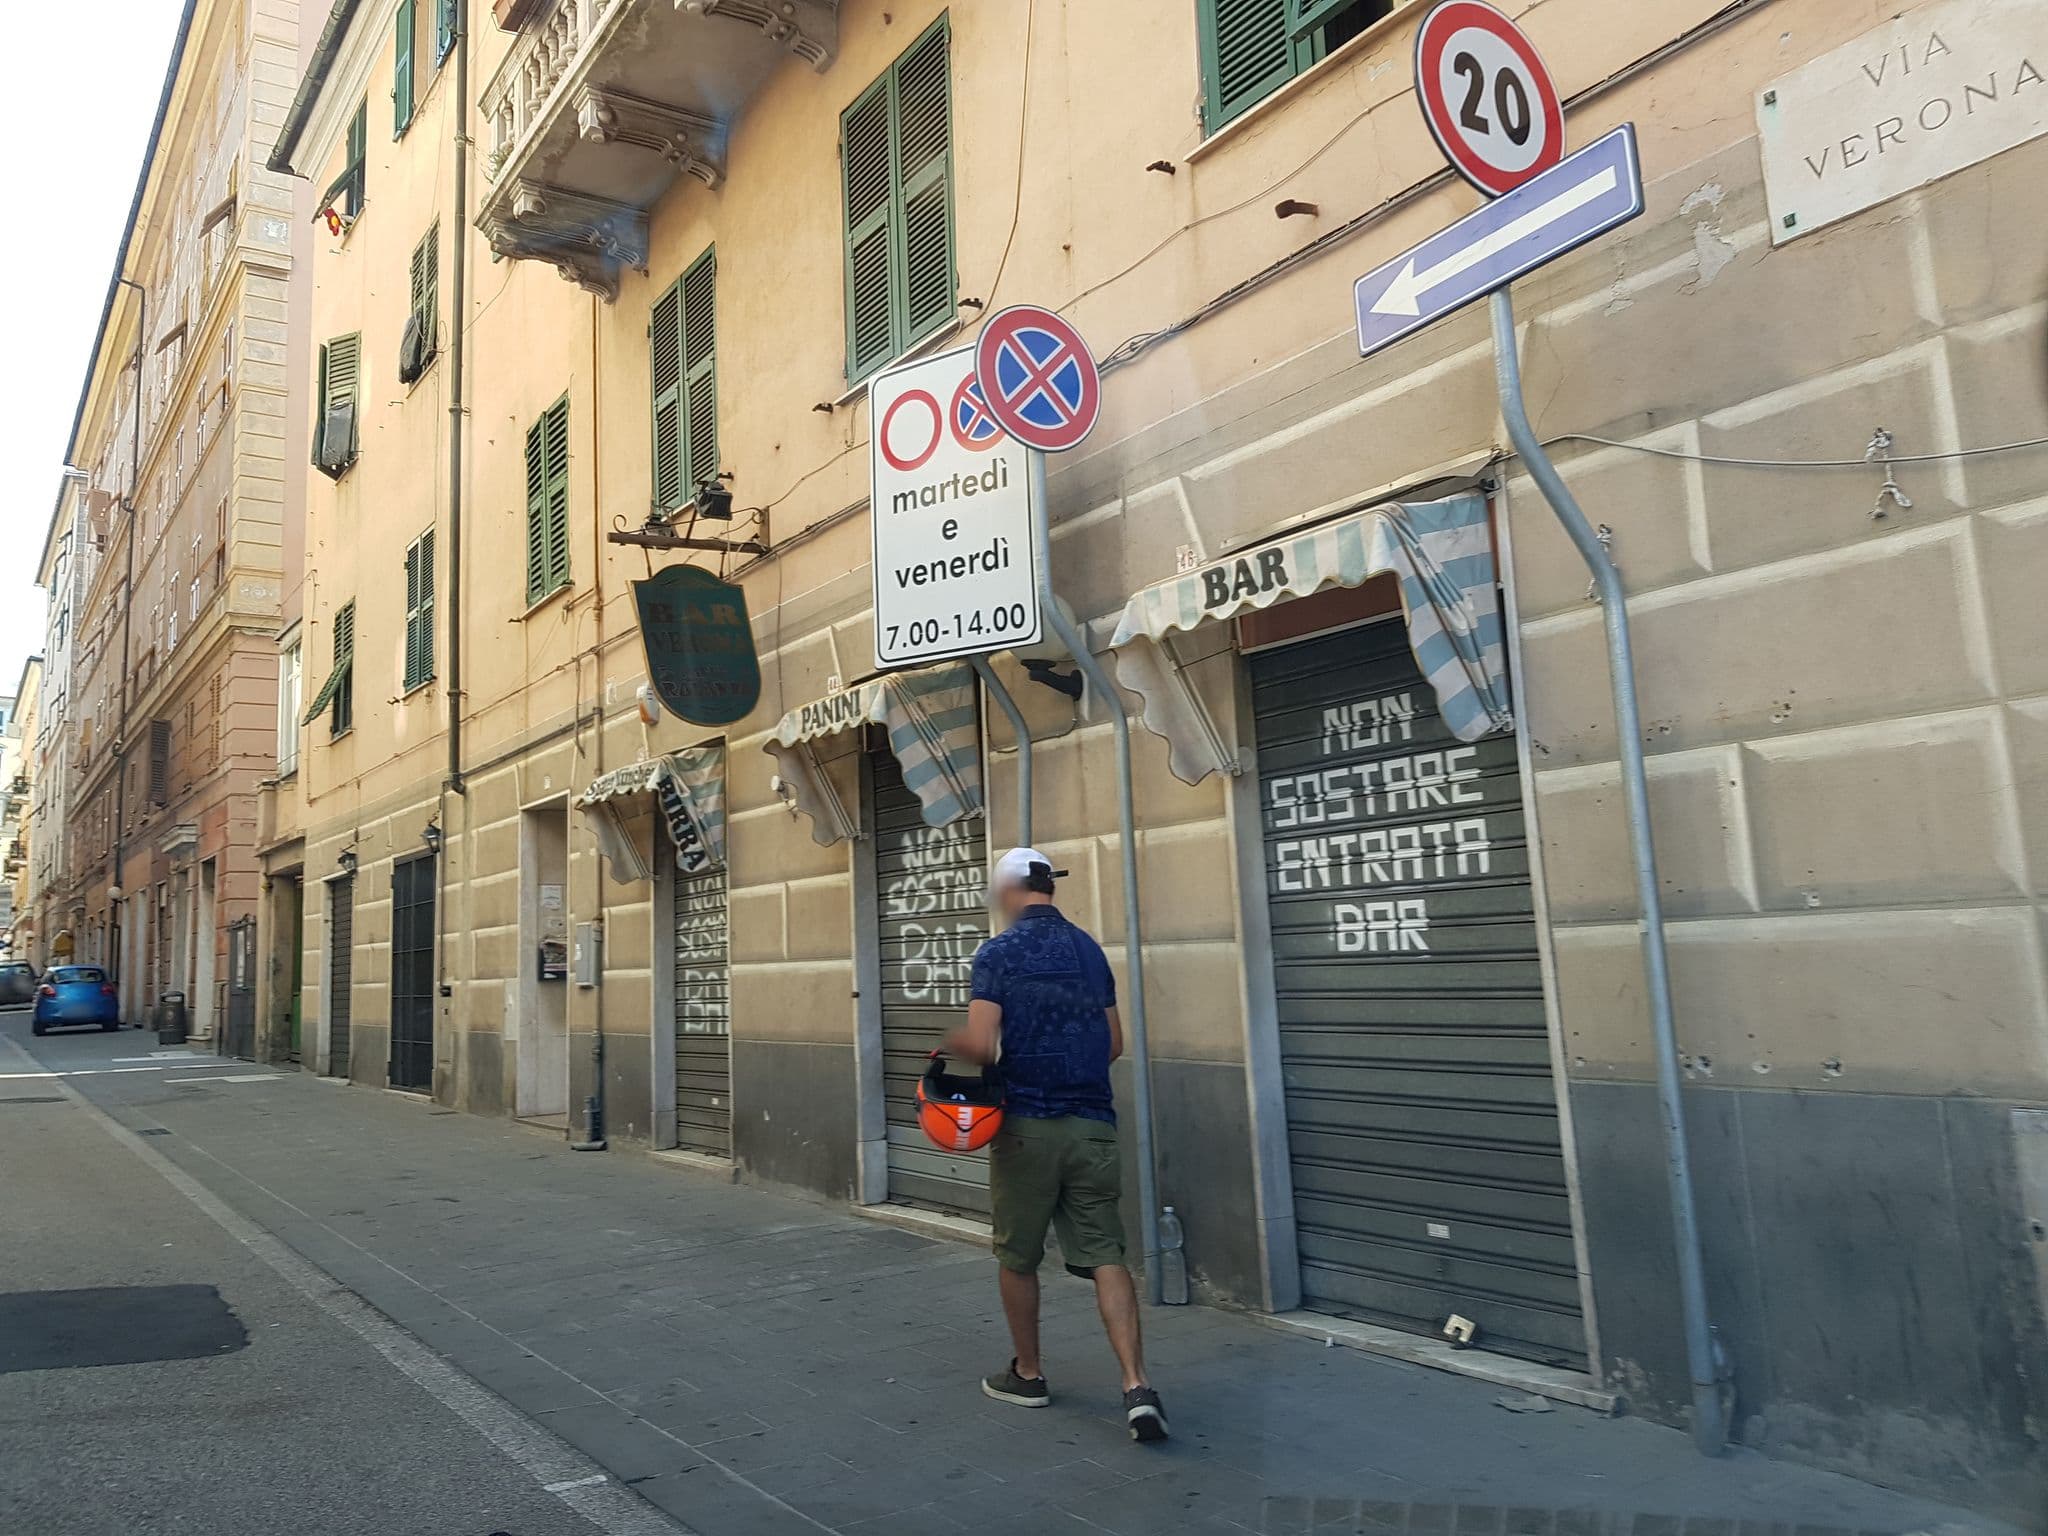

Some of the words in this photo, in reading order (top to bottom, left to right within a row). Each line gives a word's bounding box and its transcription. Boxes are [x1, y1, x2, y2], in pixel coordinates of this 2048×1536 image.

[1861, 31, 1953, 87] VIA
[1453, 50, 1532, 146] 20
[1803, 58, 2046, 180] VERONA
[892, 457, 1009, 515] martedì
[941, 518, 959, 541] e
[895, 537, 1010, 589] venerdì
[1201, 547, 1289, 610] BAR
[885, 603, 1026, 651] 7.00-14.00
[801, 688, 861, 734] PANINI
[1322, 692, 1416, 755] NON
[1270, 746, 1484, 828] SOSTARE
[656, 774, 706, 871] BIRRA
[902, 821, 972, 870] NON
[1276, 818, 1491, 891] ENTRATA
[1334, 899, 1430, 952] BAR
